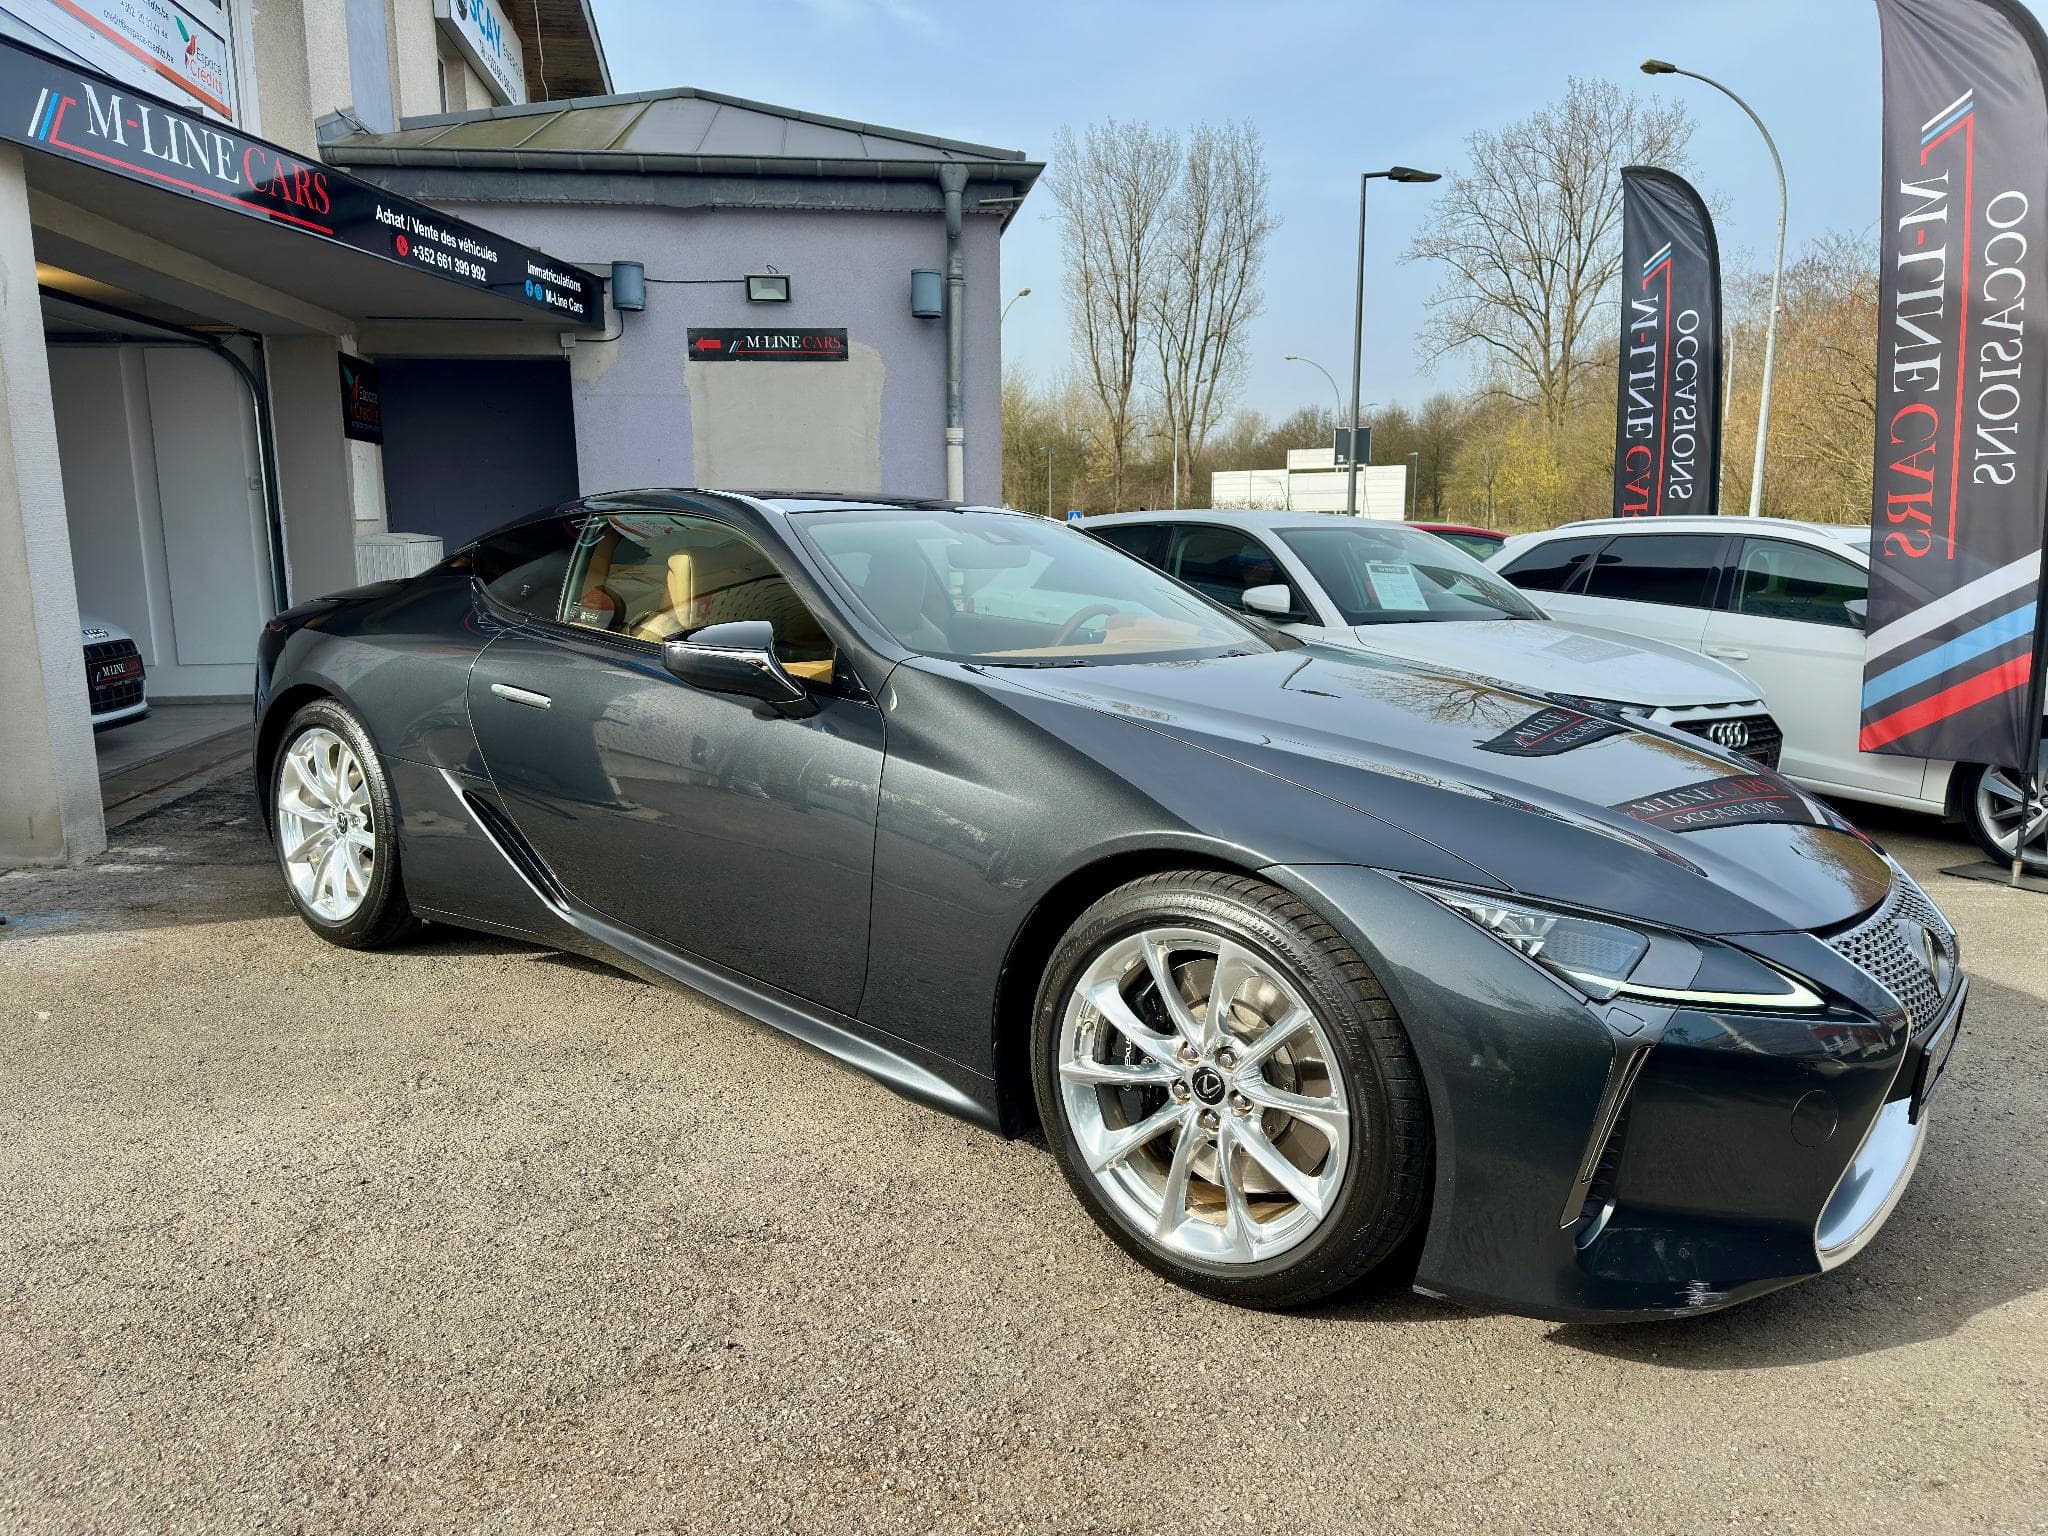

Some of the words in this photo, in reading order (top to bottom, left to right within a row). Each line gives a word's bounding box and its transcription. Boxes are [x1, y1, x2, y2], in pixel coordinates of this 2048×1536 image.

[196, 47, 223, 76] Espace
[81, 82, 240, 185] M-LINE
[243, 147, 331, 215] CARS
[375, 204, 406, 230] Achat
[411, 217, 439, 242] Vente
[440, 230, 457, 248] des
[457, 237, 498, 263] véhicules
[412, 244, 436, 265] +352
[436, 252, 453, 271] 661
[454, 258, 470, 276] 399
[470, 264, 487, 282] 992
[527, 259, 582, 293] Immatriculations
[545, 288, 568, 309] M-Line
[568, 297, 584, 314] Cars
[745, 335, 801, 348] M-LINE
[802, 335, 841, 349] CARS
[1632, 786, 1715, 814] M-LINE
[1673, 801, 1785, 824] OCCASIONS
